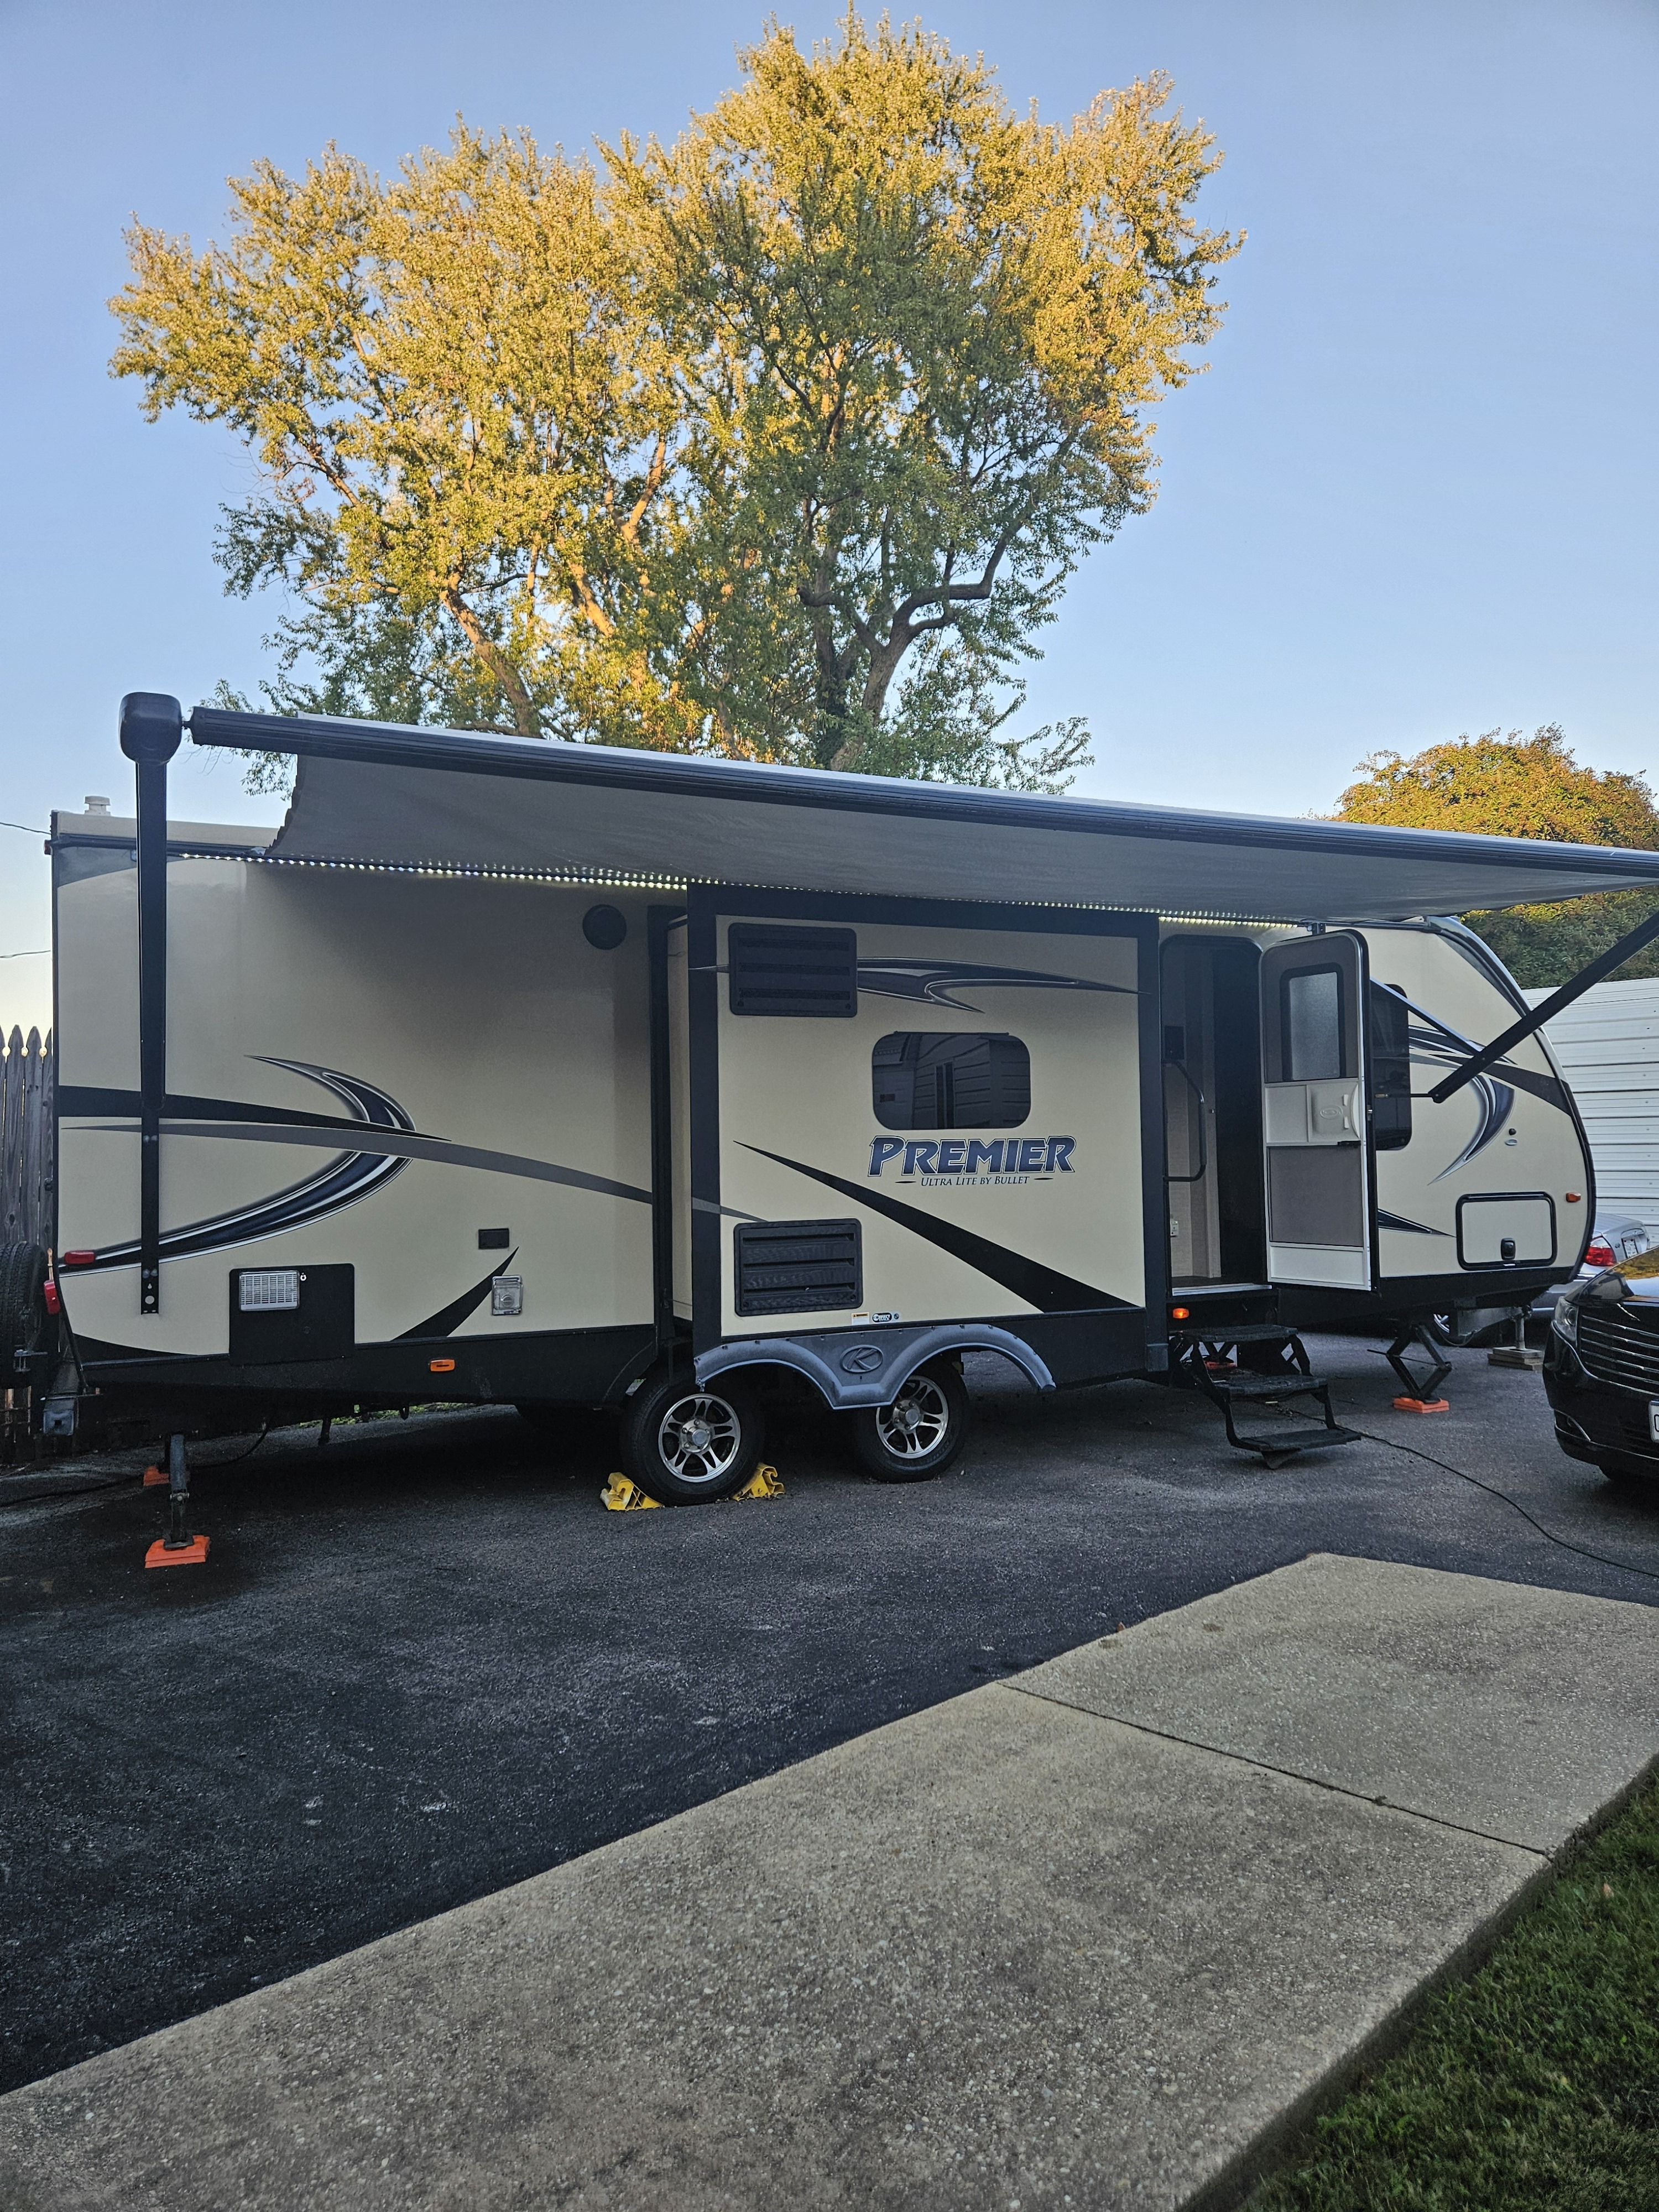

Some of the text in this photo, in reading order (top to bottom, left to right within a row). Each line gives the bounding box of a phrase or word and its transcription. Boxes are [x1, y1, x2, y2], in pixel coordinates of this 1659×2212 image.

[868, 1135, 1076, 1177] PREMIER
[921, 1177, 952, 1186] ULTRA
[956, 1177, 977, 1185] LITE
[995, 1176, 1030, 1184] BULLET
